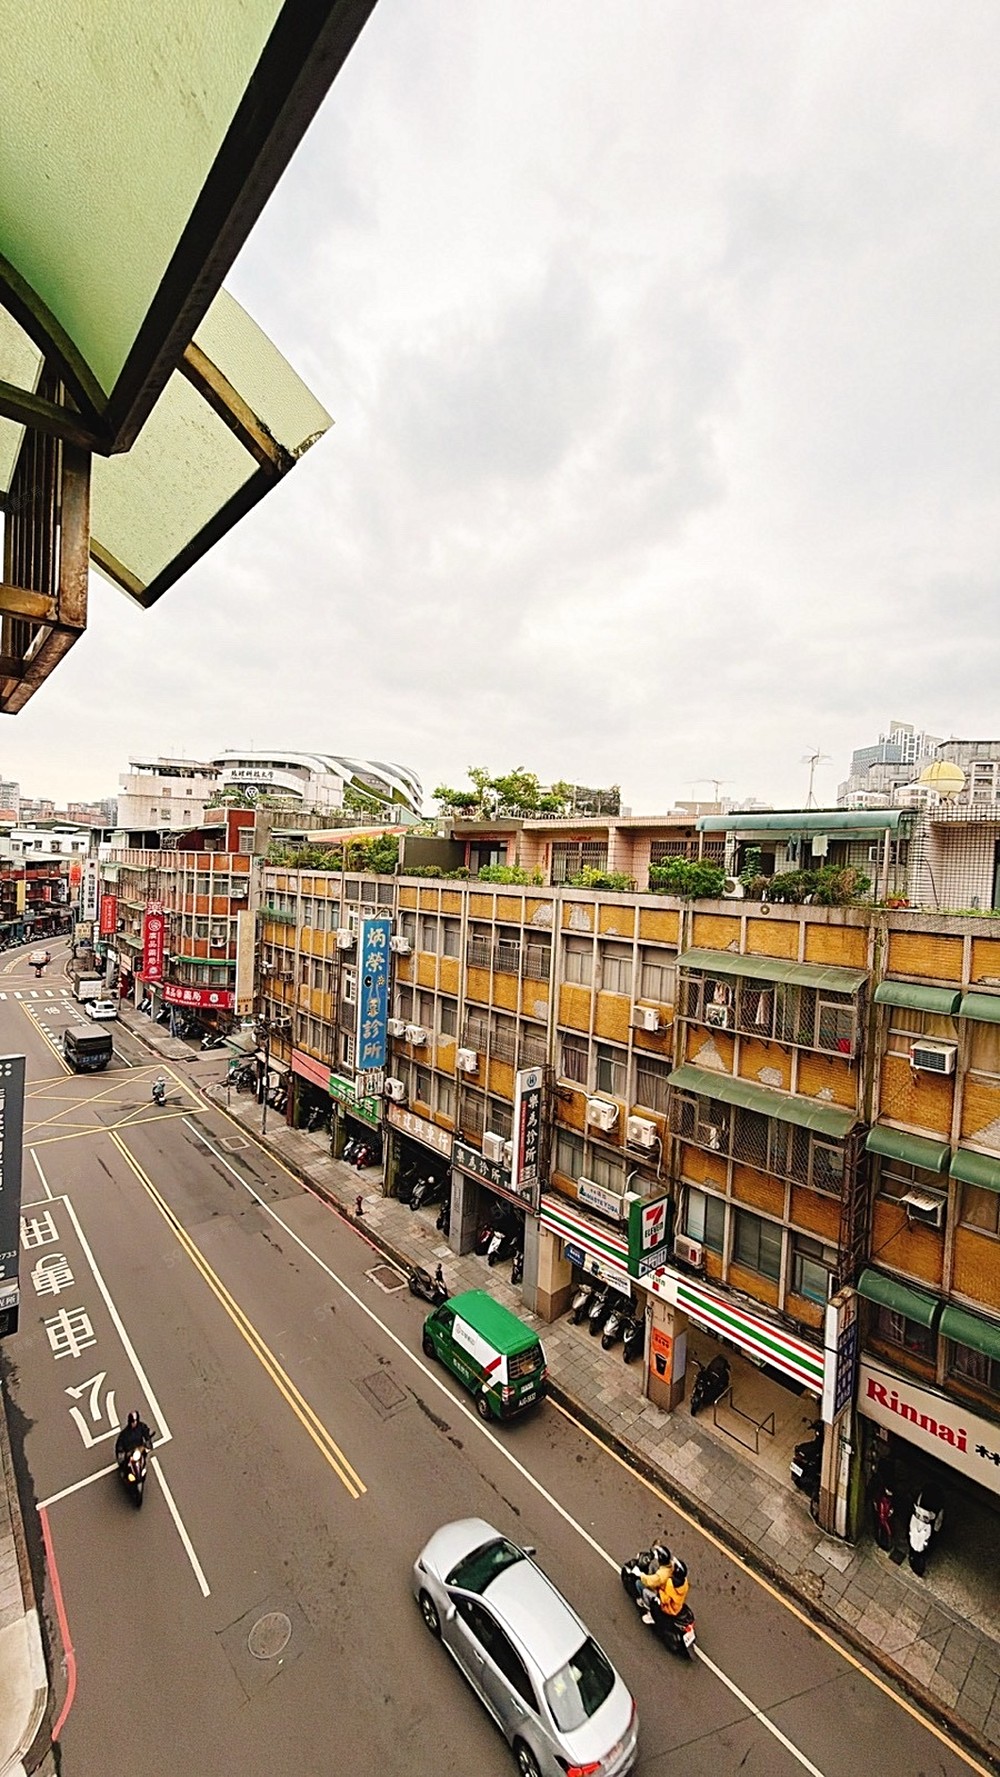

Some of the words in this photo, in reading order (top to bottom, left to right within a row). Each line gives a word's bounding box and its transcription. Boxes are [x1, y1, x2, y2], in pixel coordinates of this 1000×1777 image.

[19, 1209, 121, 1450] 公車專用
[866, 1378, 968, 1453] Rinnai
